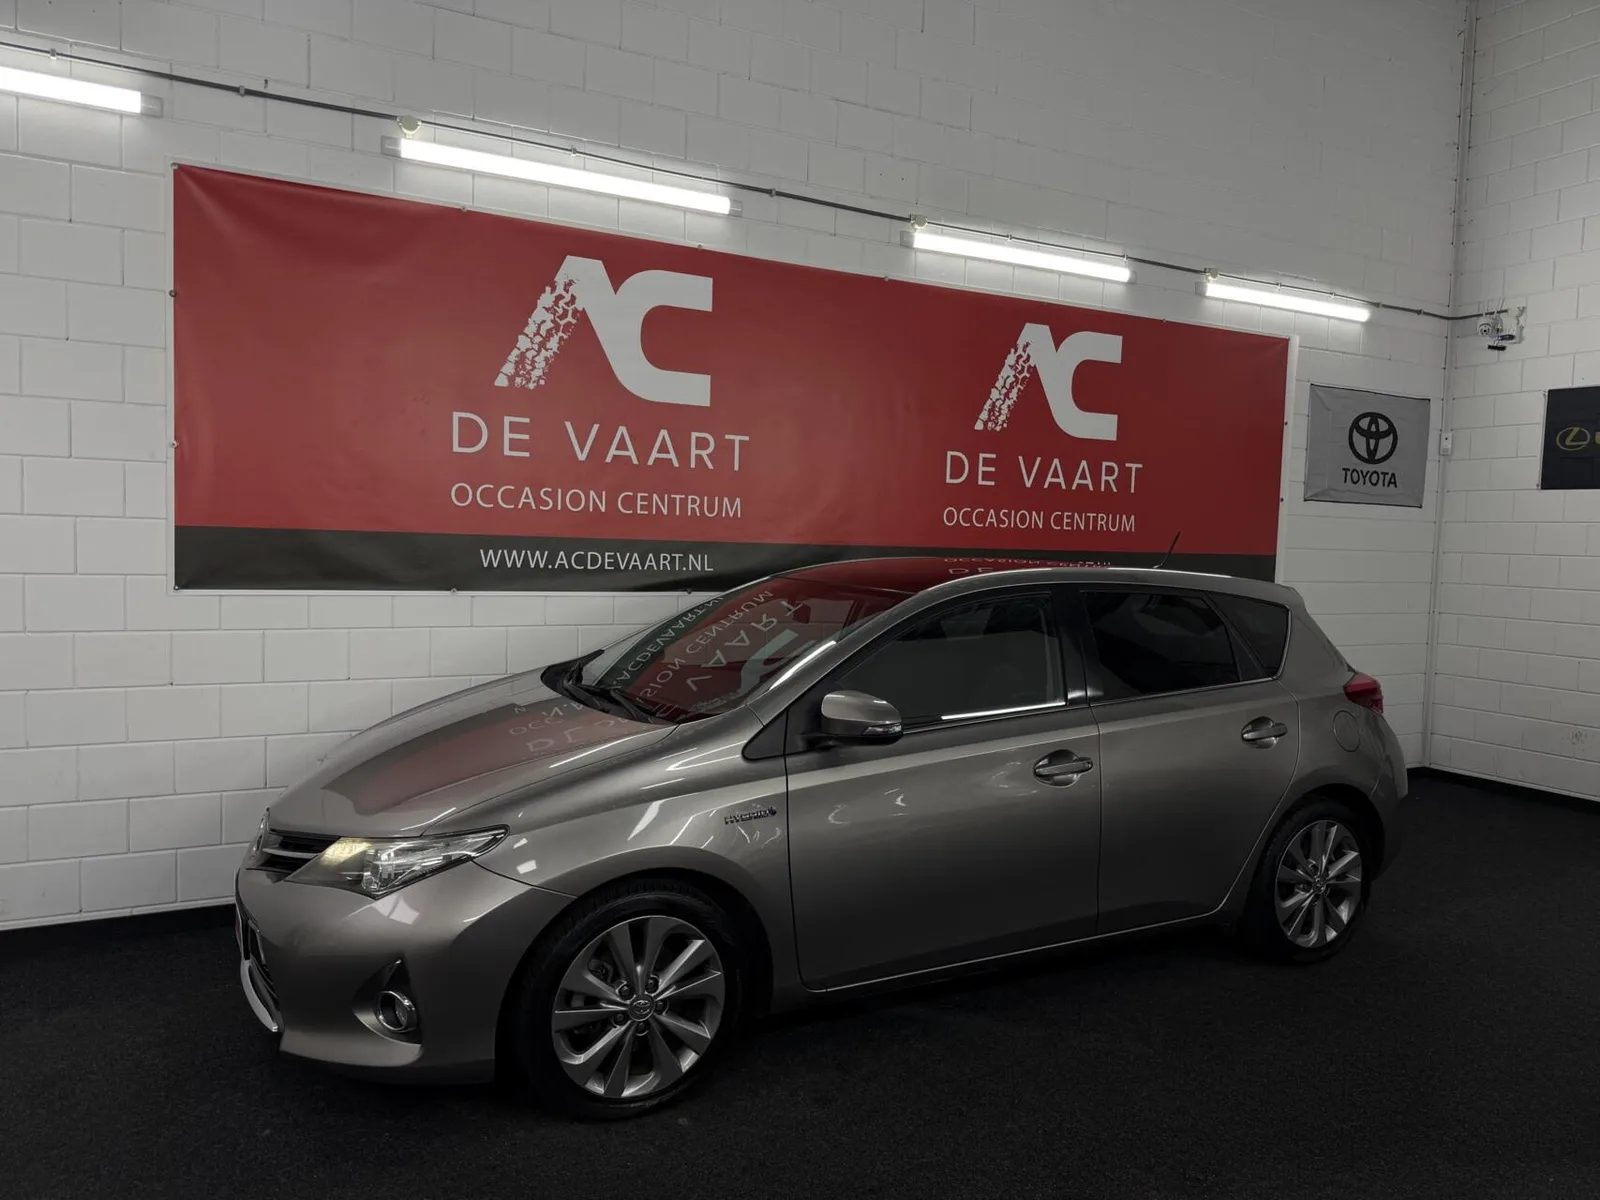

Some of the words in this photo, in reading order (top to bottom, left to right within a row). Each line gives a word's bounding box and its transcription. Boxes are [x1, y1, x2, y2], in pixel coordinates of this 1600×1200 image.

[494, 255, 713, 407] AC
[974, 322, 1123, 441] AC
[452, 411, 530, 457] DE
[564, 421, 750, 471] VAART
[945, 451, 997, 486] DE
[1018, 455, 1143, 493] VAART
[1342, 468, 1397, 488] TOYOTA
[451, 483, 607, 512] OCCASION
[617, 492, 742, 518] CENTRUM
[943, 507, 1044, 529] OCCASION
[1050, 511, 1135, 532] CENTRUM
[480, 549, 714, 571] WWW.ACDEVAART.NL
